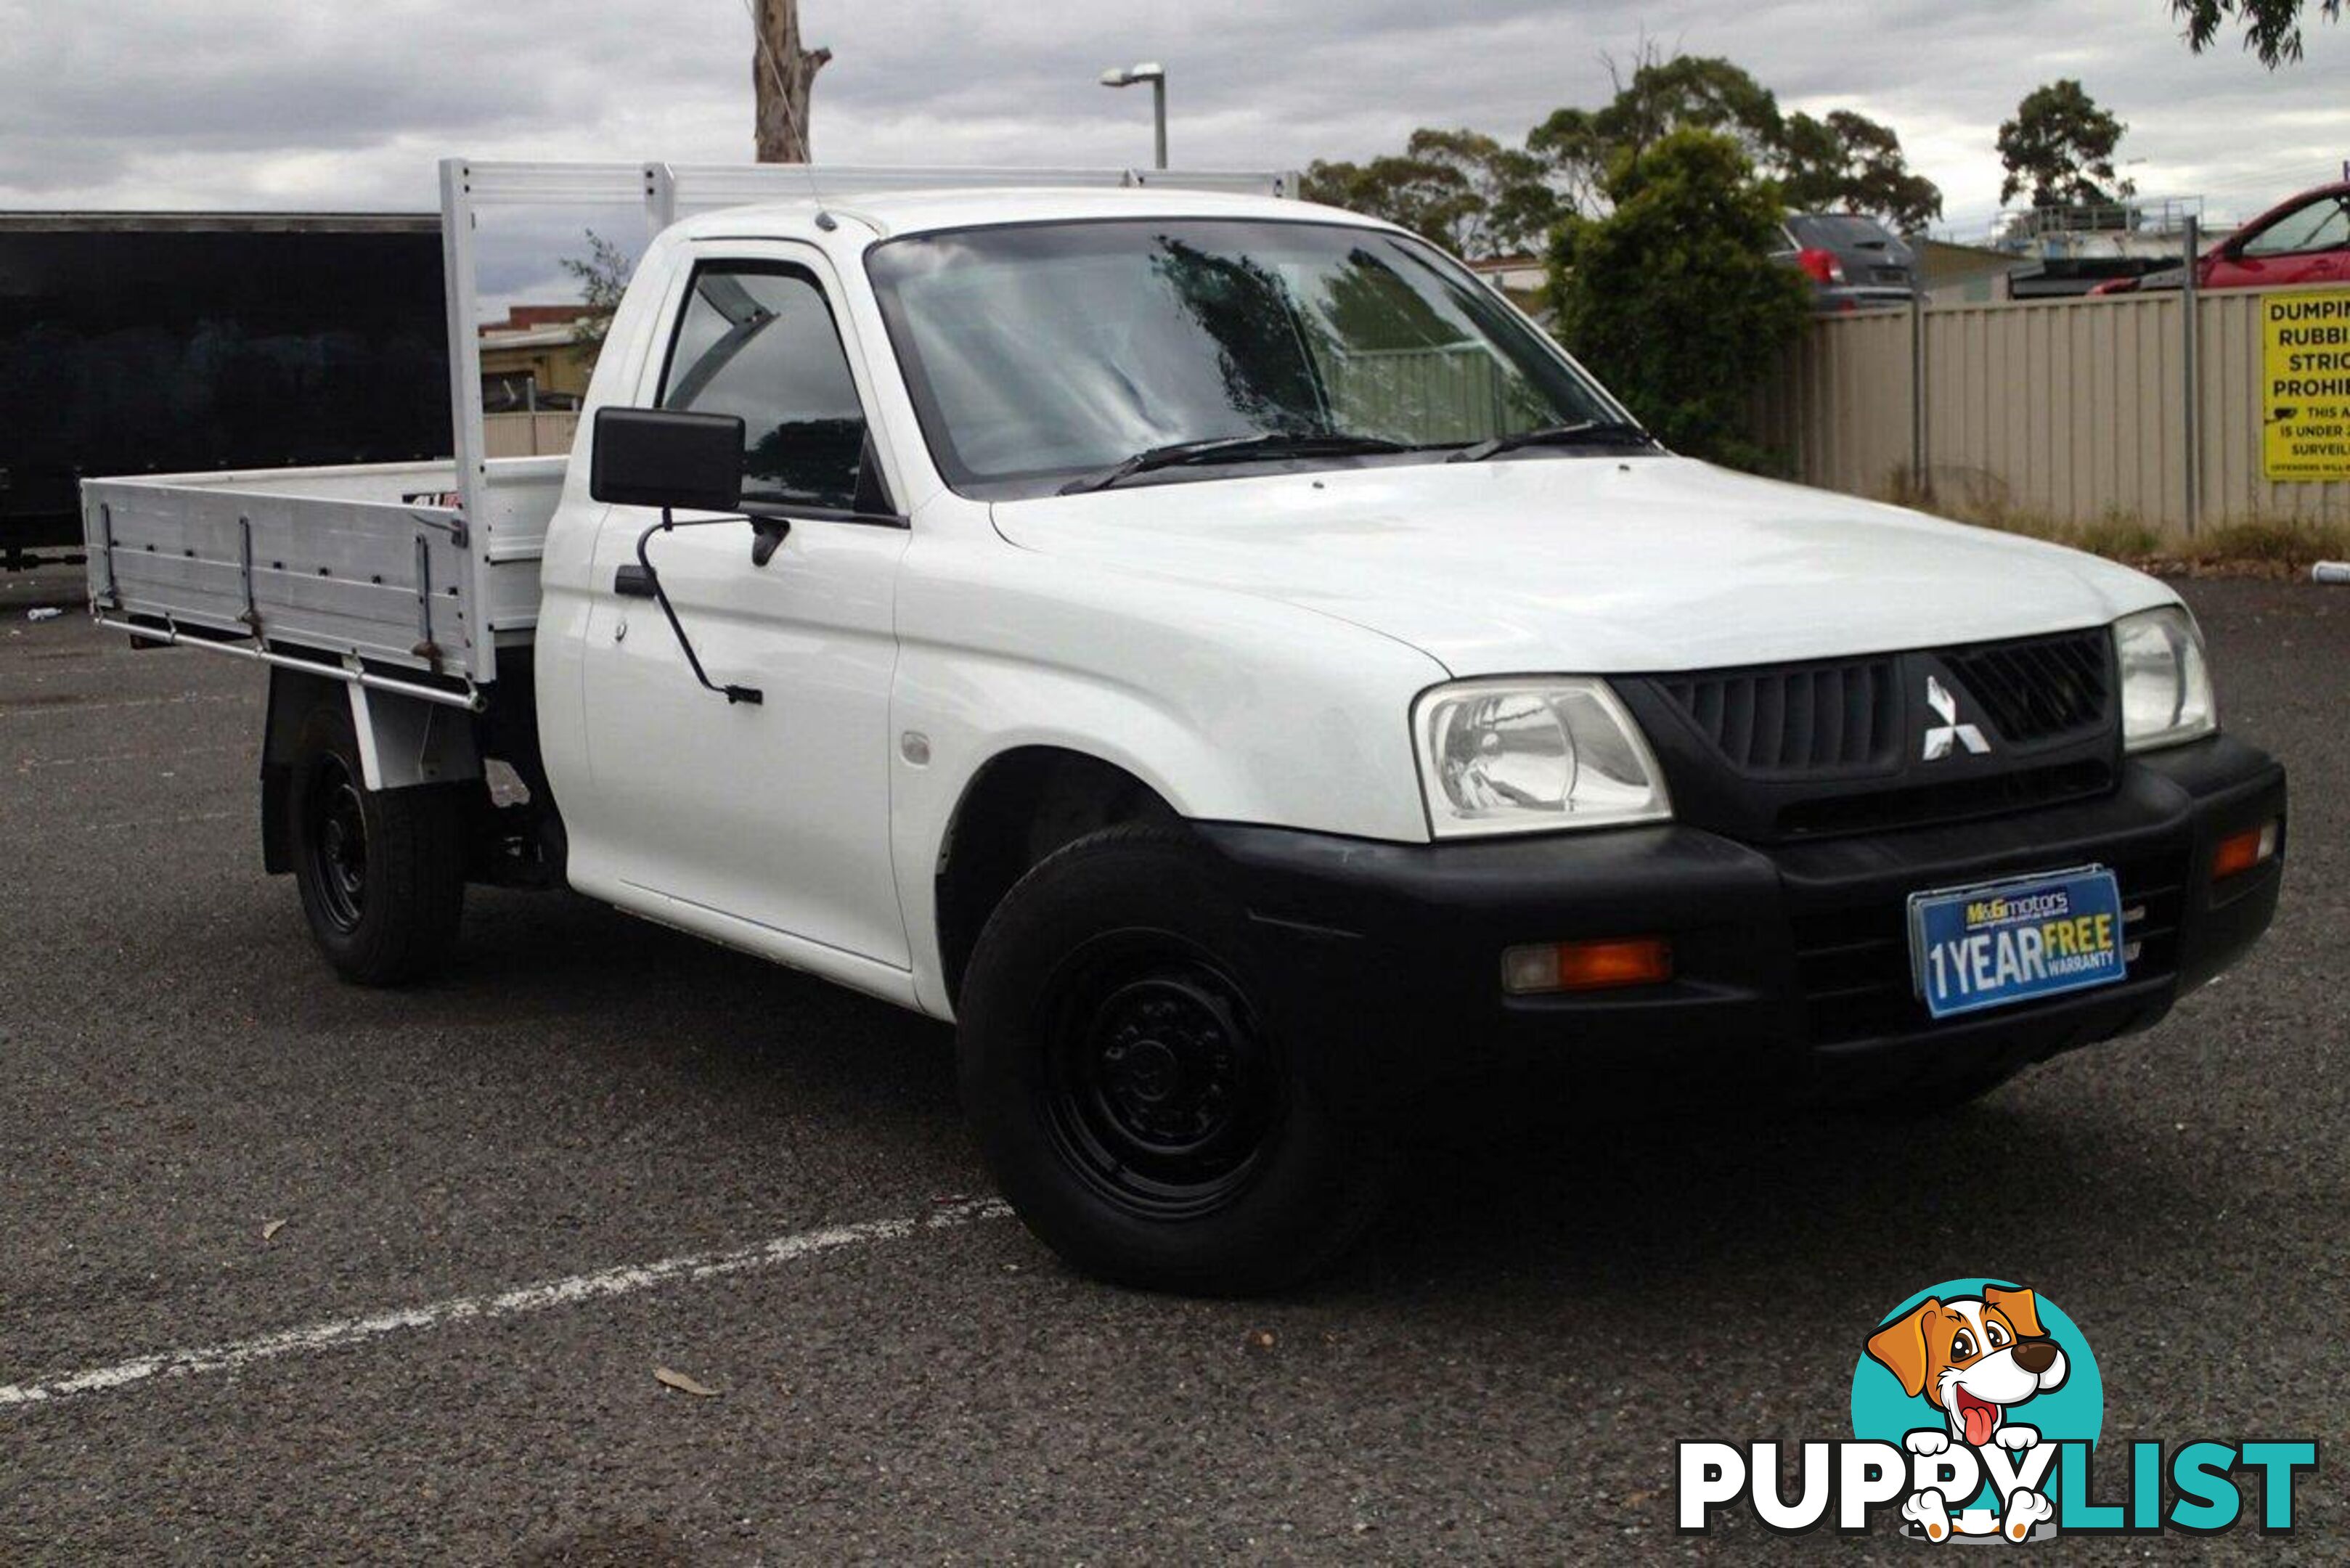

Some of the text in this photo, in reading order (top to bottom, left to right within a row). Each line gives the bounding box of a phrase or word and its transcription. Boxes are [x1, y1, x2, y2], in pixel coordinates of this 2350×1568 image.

[2289, 351, 2350, 371] STRIC
[2307, 407, 2337, 418] THIS
[2280, 425, 2292, 437] IS
[2296, 425, 2342, 437] UNDER
[1930, 943, 1947, 999] 1
[1949, 927, 2048, 995] YEAR
[2041, 913, 2113, 958] FREE
[2047, 950, 2115, 976] WARRANTY
